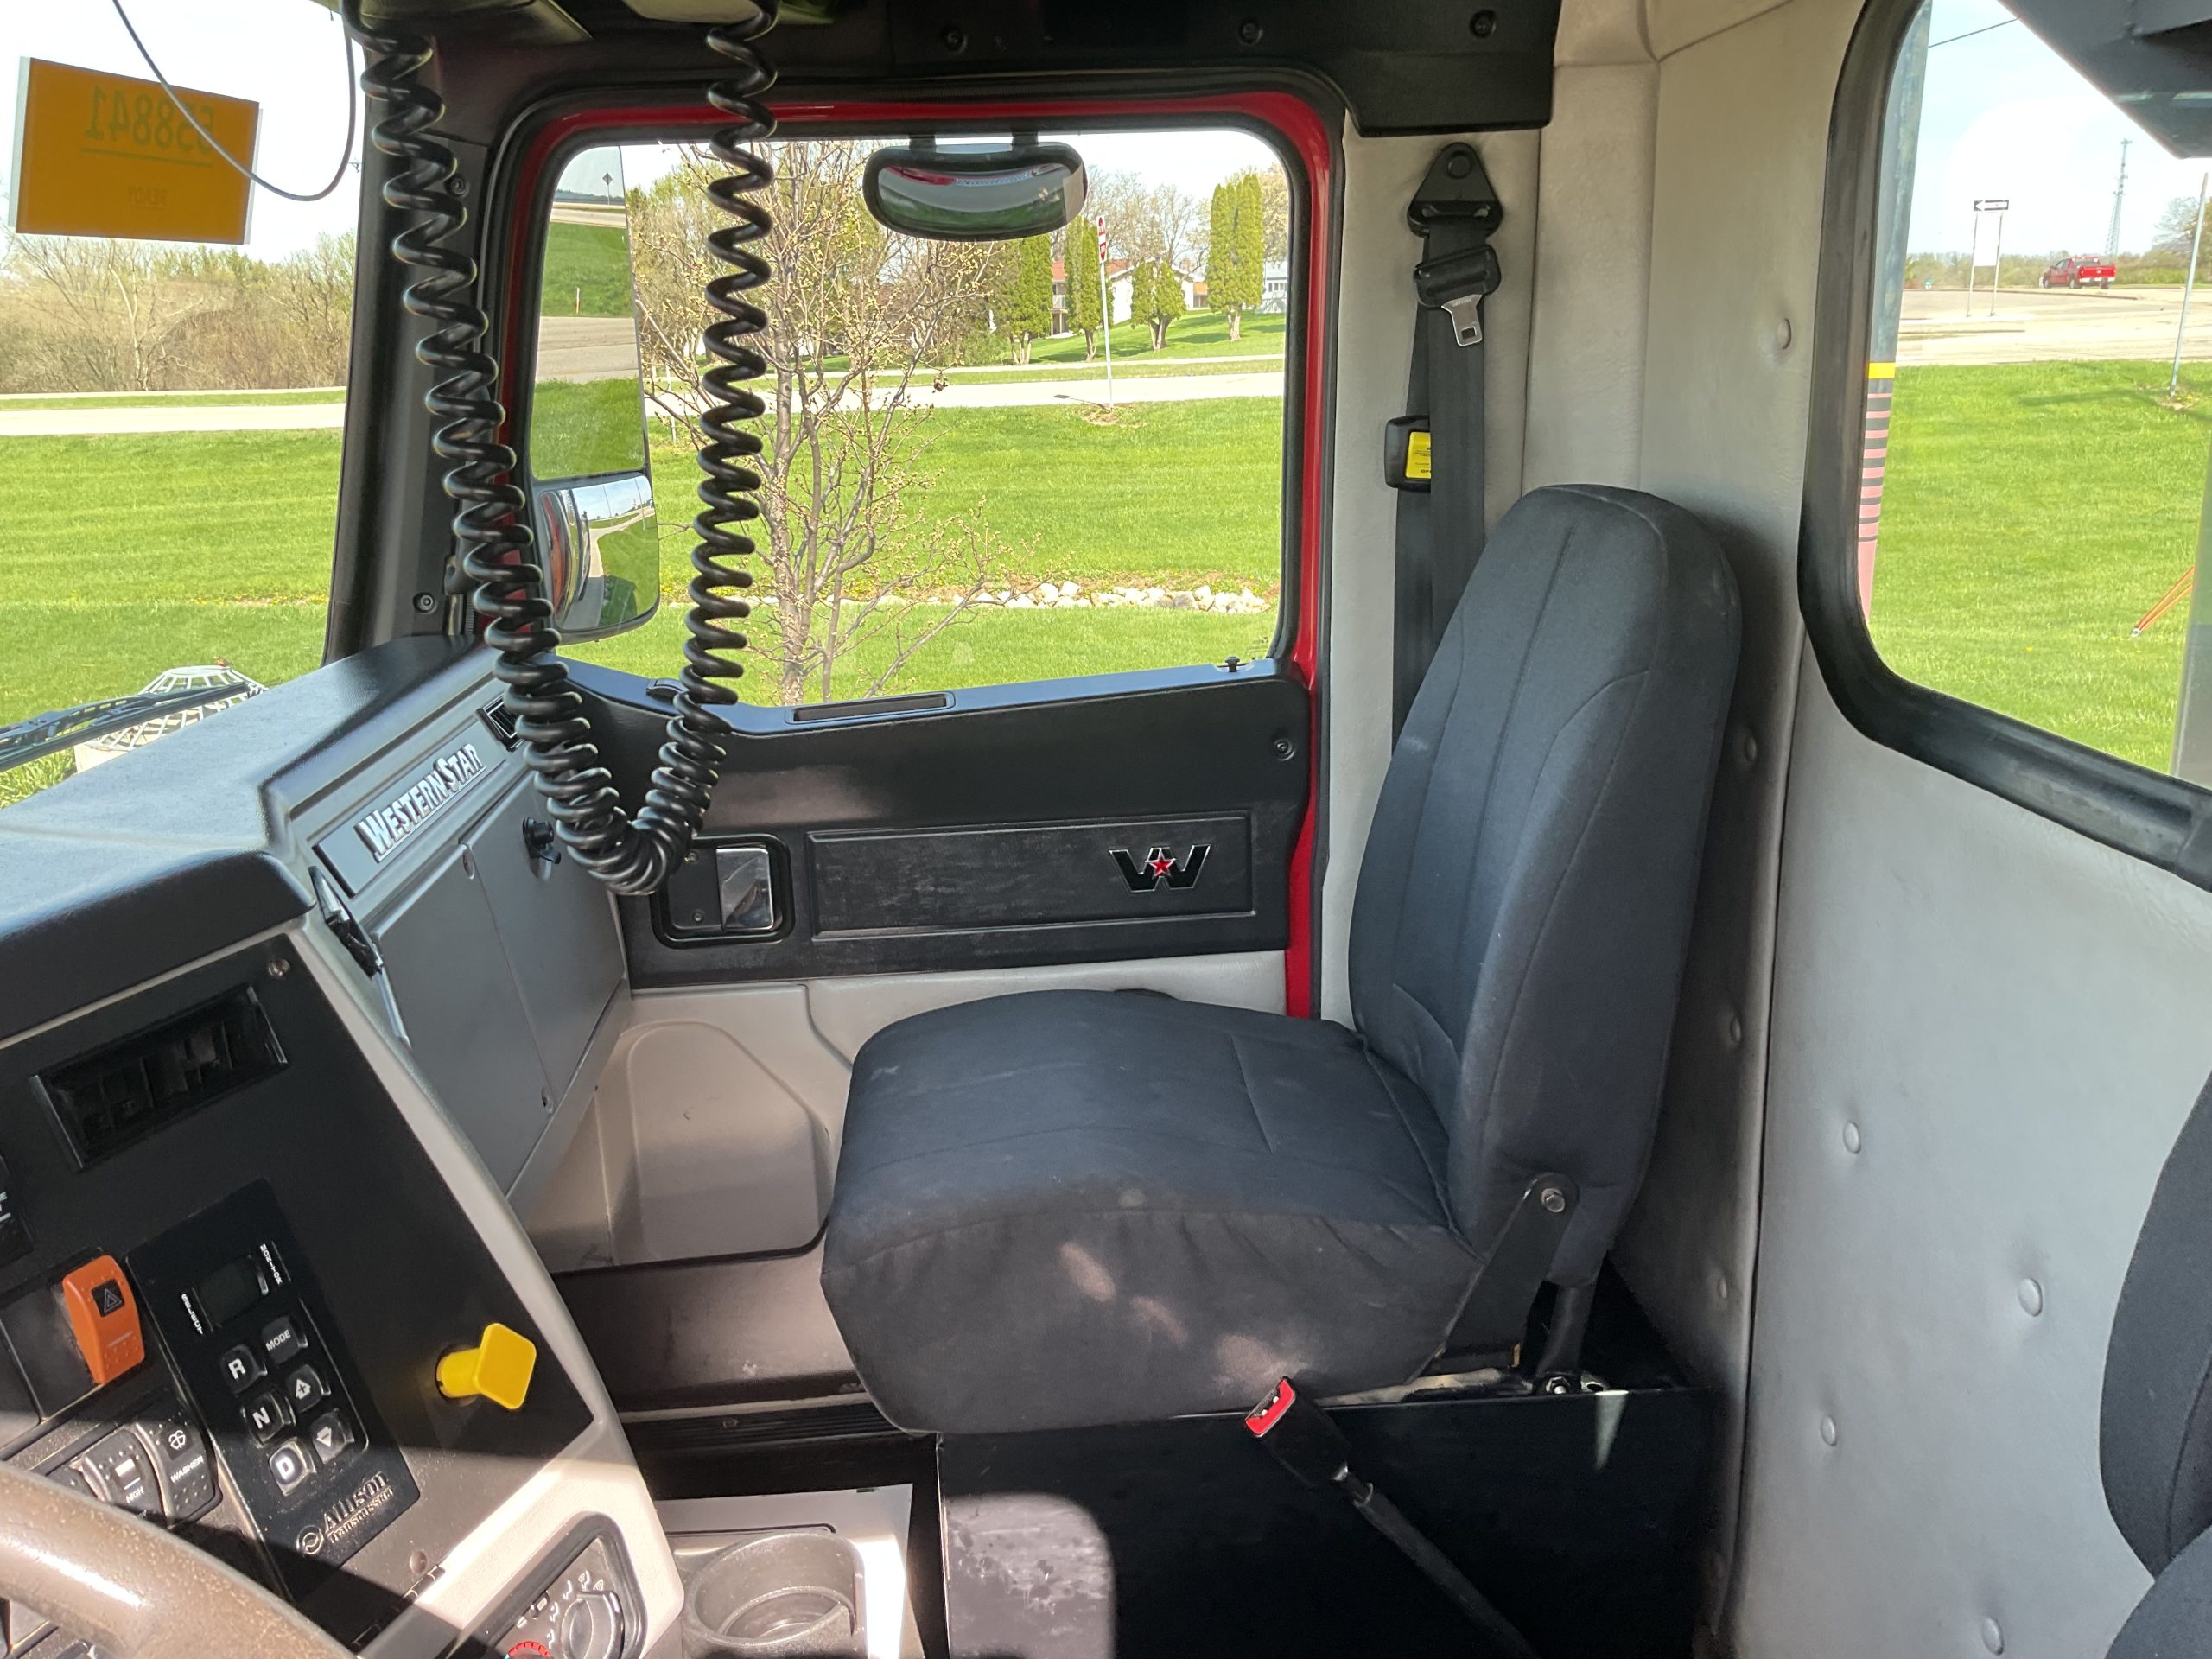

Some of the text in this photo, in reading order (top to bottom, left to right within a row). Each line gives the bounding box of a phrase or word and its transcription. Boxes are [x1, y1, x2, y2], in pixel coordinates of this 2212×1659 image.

[260, 1243, 283, 1285] MONITOR
[181, 1294, 203, 1334] SELECT
[265, 1329, 291, 1351] MODE
[228, 1358, 246, 1380] R
[252, 1407, 270, 1429] N
[170, 1455, 204, 1483] WASHER
[276, 1456, 296, 1480] D
[126, 1486, 144, 1503] HIGH
